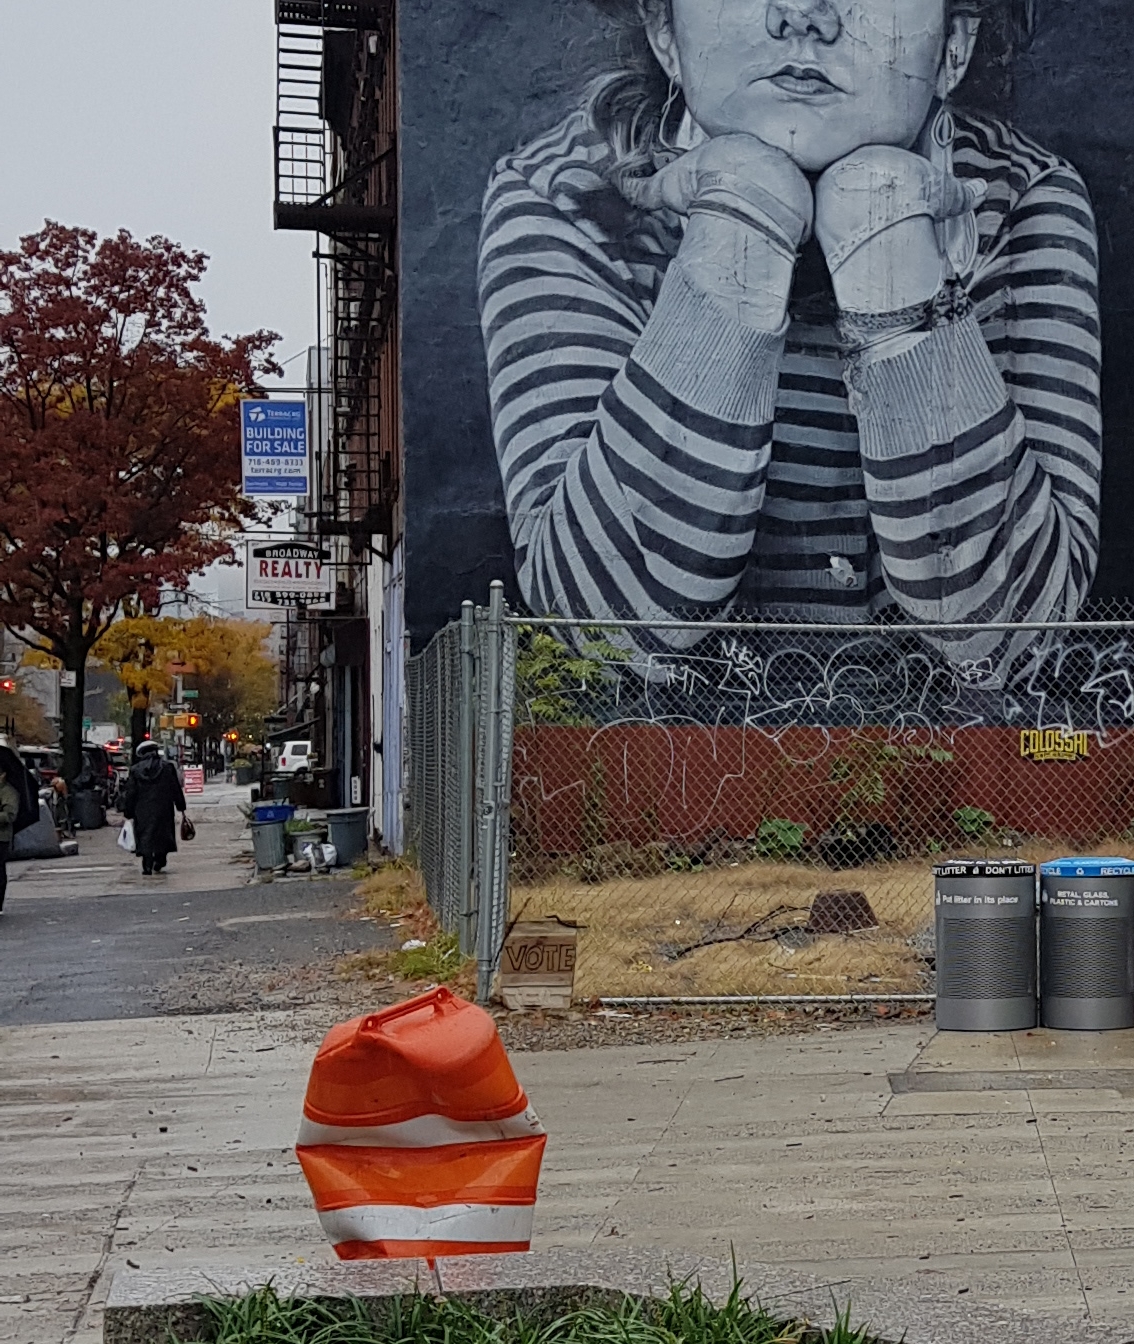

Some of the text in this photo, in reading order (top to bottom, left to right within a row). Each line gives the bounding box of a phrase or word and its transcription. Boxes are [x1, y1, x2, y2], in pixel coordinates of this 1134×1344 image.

[246, 426, 305, 440] BUILDING
[246, 440, 305, 453] FOR SALE
[265, 548, 320, 559] BROADWAY
[259, 559, 322, 579] REALTY
[941, 866, 967, 875] LITTER
[985, 866, 1013, 875] DON'T
[942, 894, 953, 904] Put
[954, 894, 972, 904] litter
[974, 895, 982, 904] in
[985, 895, 995, 904] its
[1049, 897, 1076, 906] PLASTIC
[1084, 899, 1119, 907] CARTONS
[504, 943, 577, 972] VOTE
